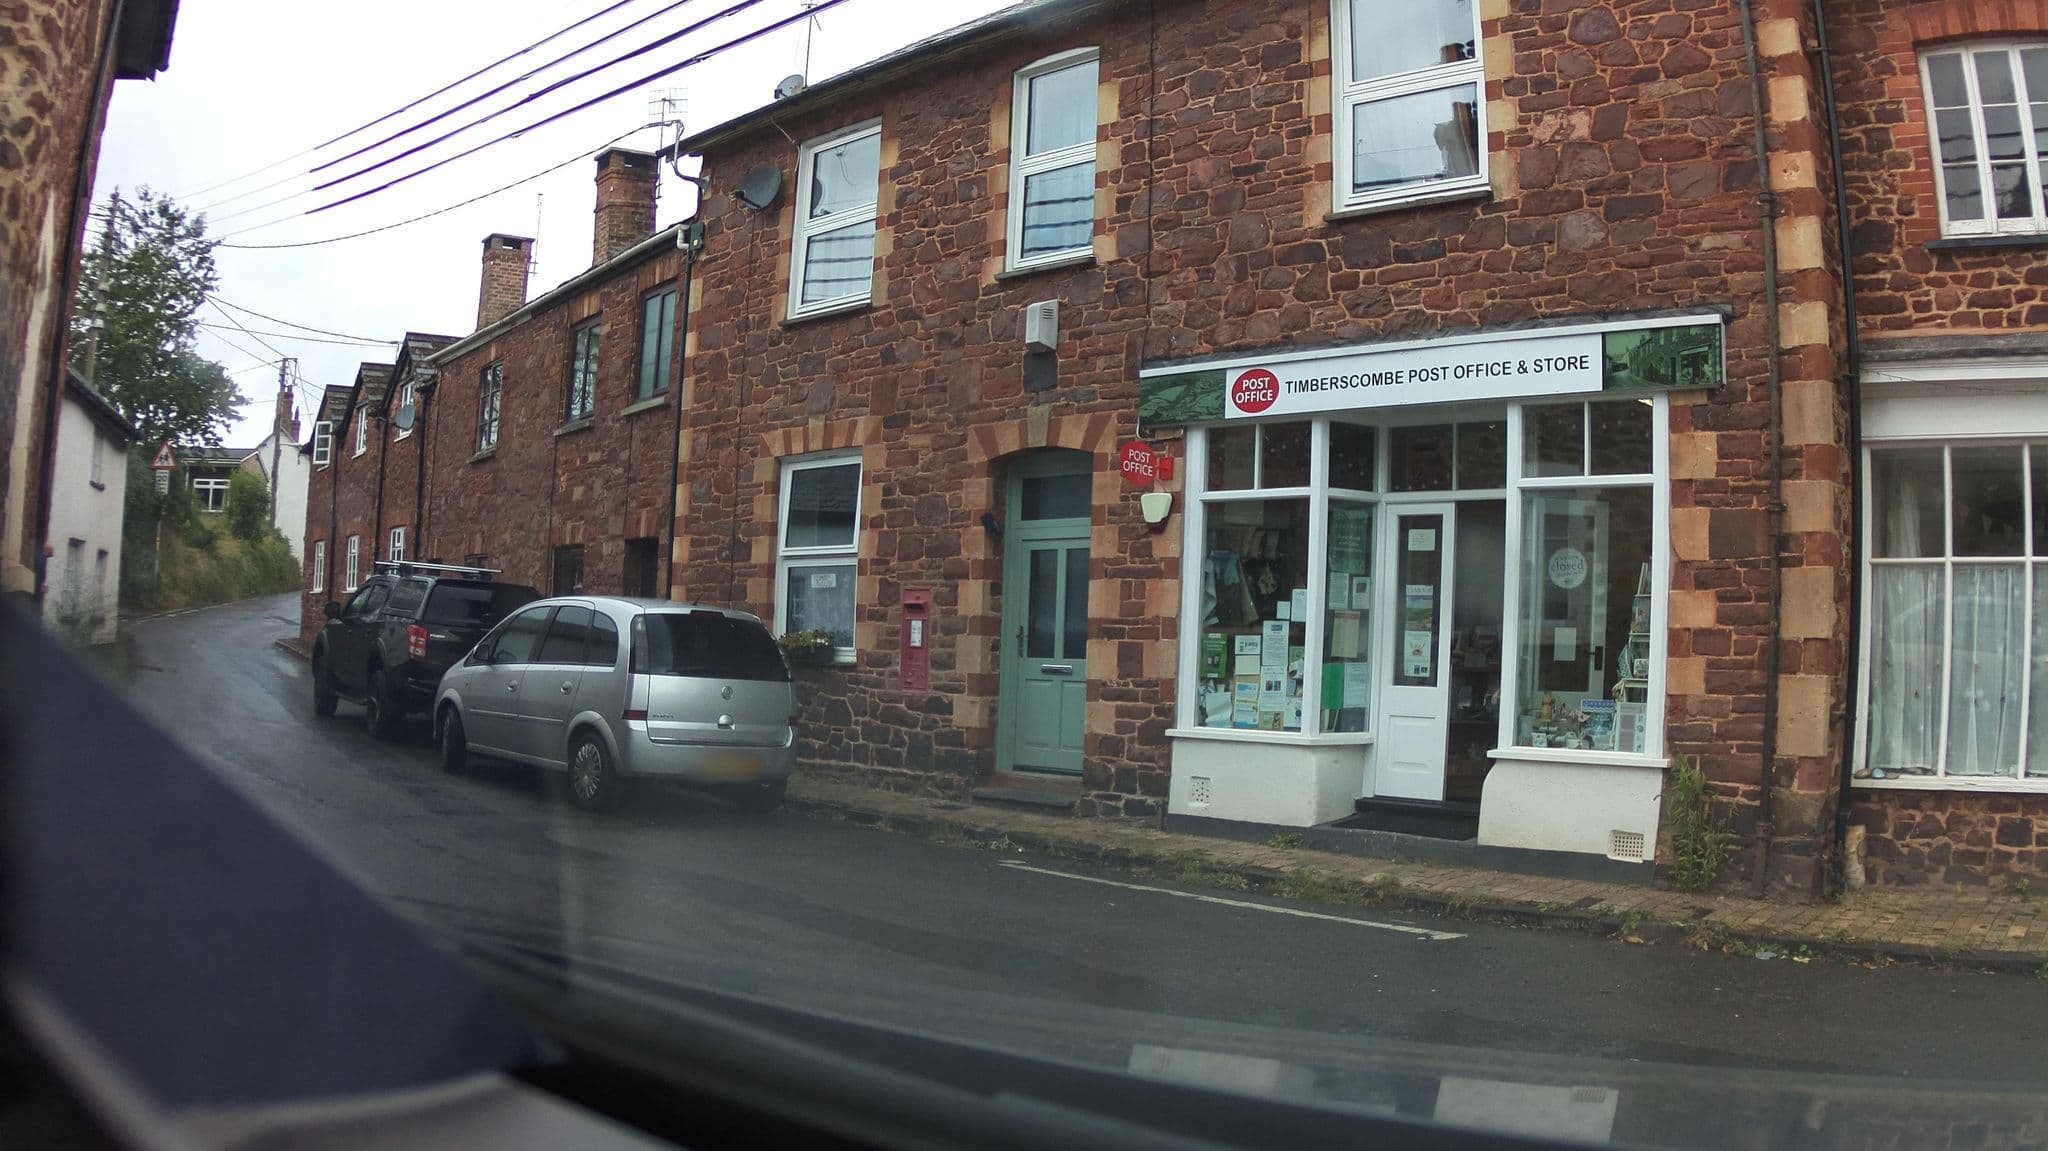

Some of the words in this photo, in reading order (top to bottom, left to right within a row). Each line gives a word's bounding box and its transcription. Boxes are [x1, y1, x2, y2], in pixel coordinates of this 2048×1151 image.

[1285, 370, 1404, 394] TIMBERSCOMBE
[1408, 366, 1449, 383] POST
[1453, 361, 1512, 380] OFFICE
[1517, 360, 1529, 375] &
[1533, 355, 1590, 373] STORE
[1242, 377, 1270, 391] POST
[1235, 389, 1273, 404] OFFICE
[1128, 449, 1151, 464] POST
[1122, 460, 1153, 477] OFFICE
[1550, 559, 1583, 571] closed
